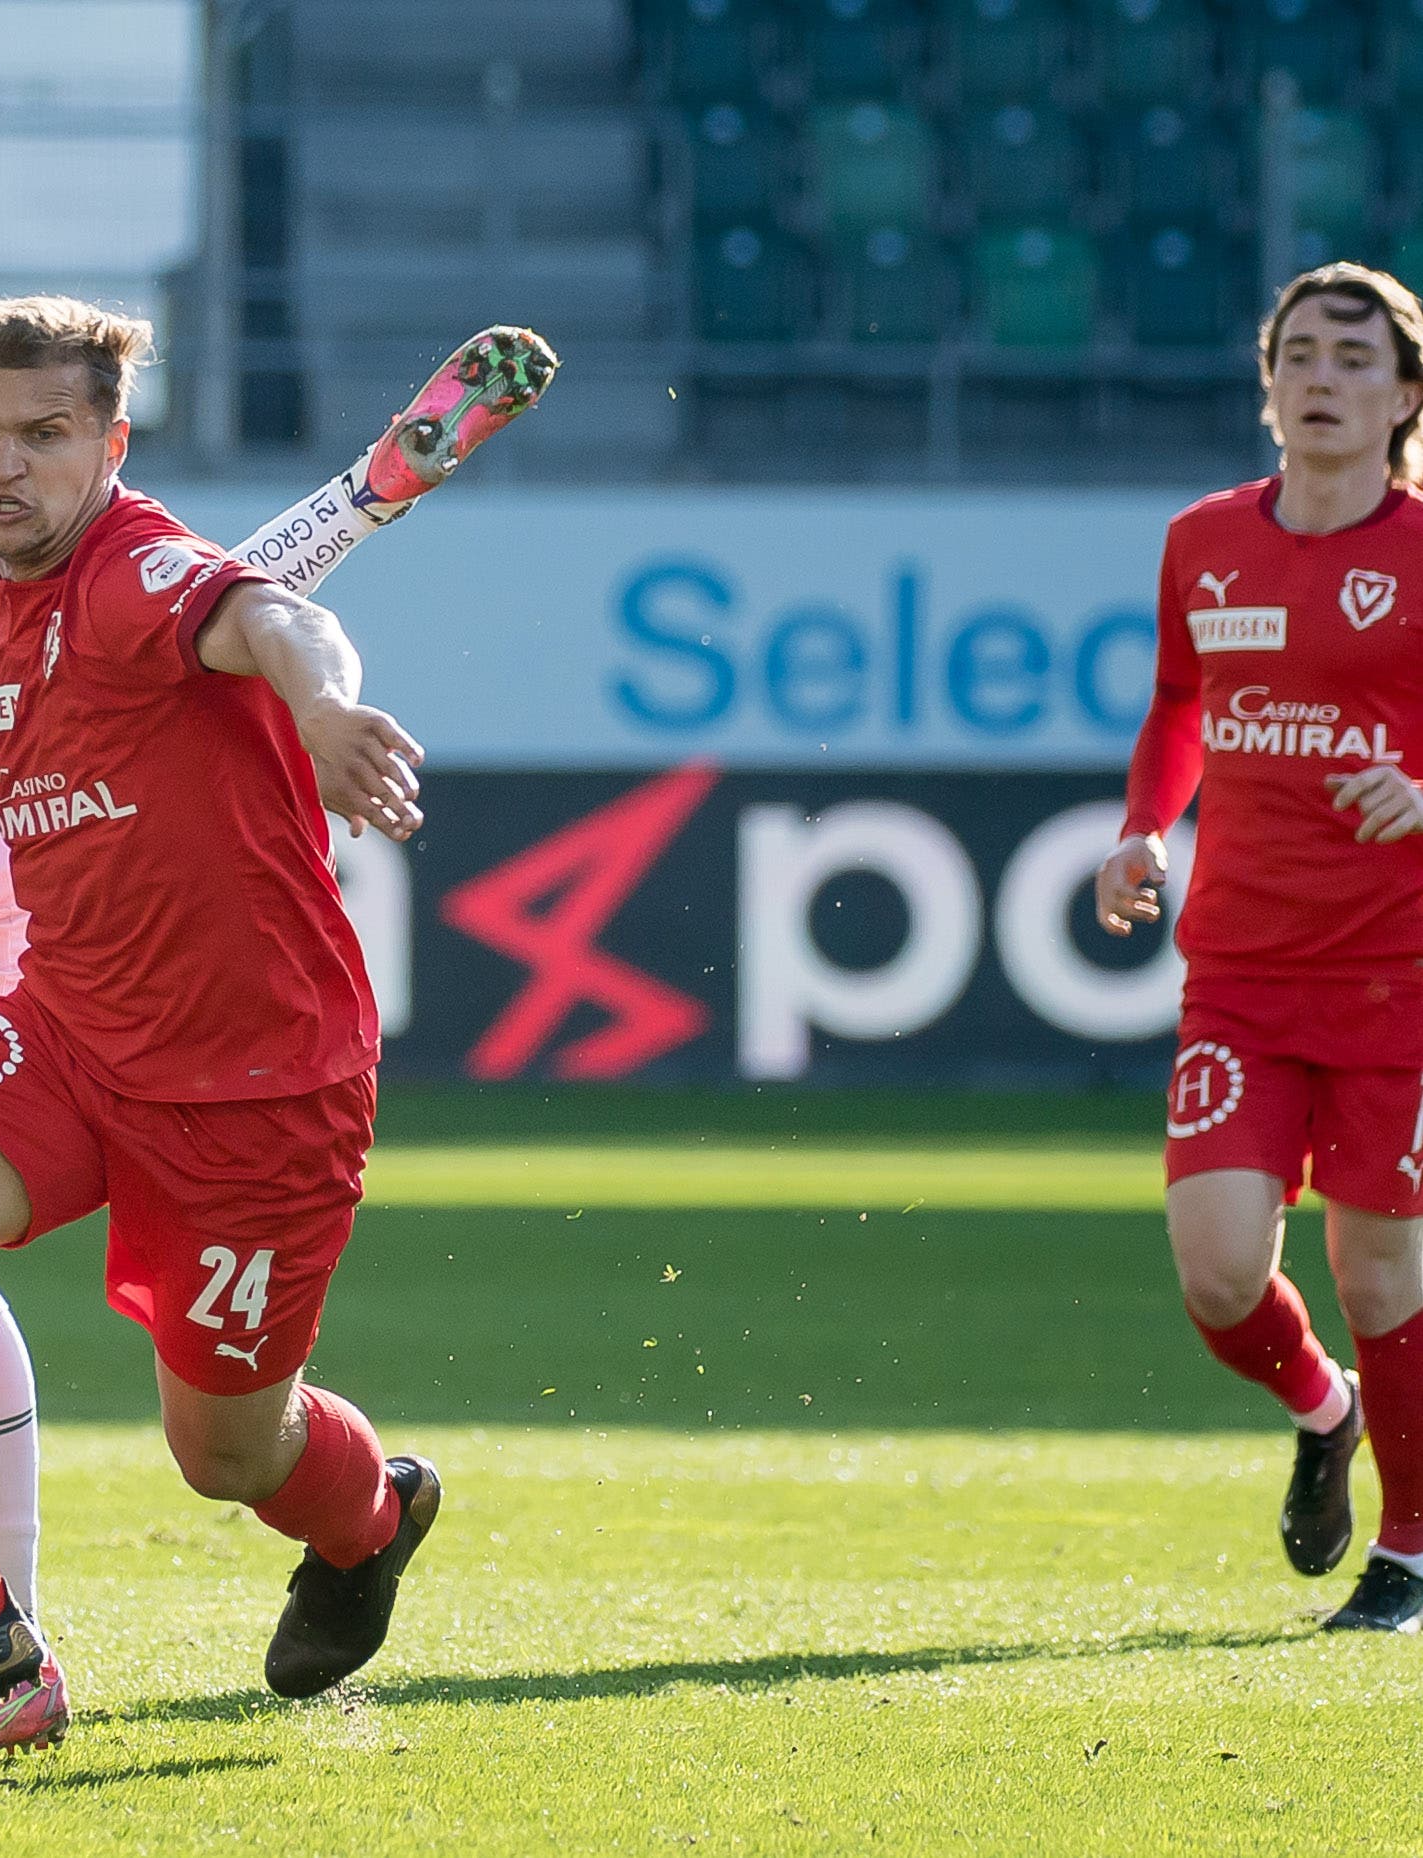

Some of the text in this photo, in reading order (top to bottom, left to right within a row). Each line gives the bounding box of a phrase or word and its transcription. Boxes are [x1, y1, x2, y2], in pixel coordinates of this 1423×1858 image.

[239, 518, 314, 568] GROU
[1229, 685, 1341, 723] CASINO
[1201, 710, 1404, 764] ADMIRAL
[185, 1245, 275, 1330] 24
